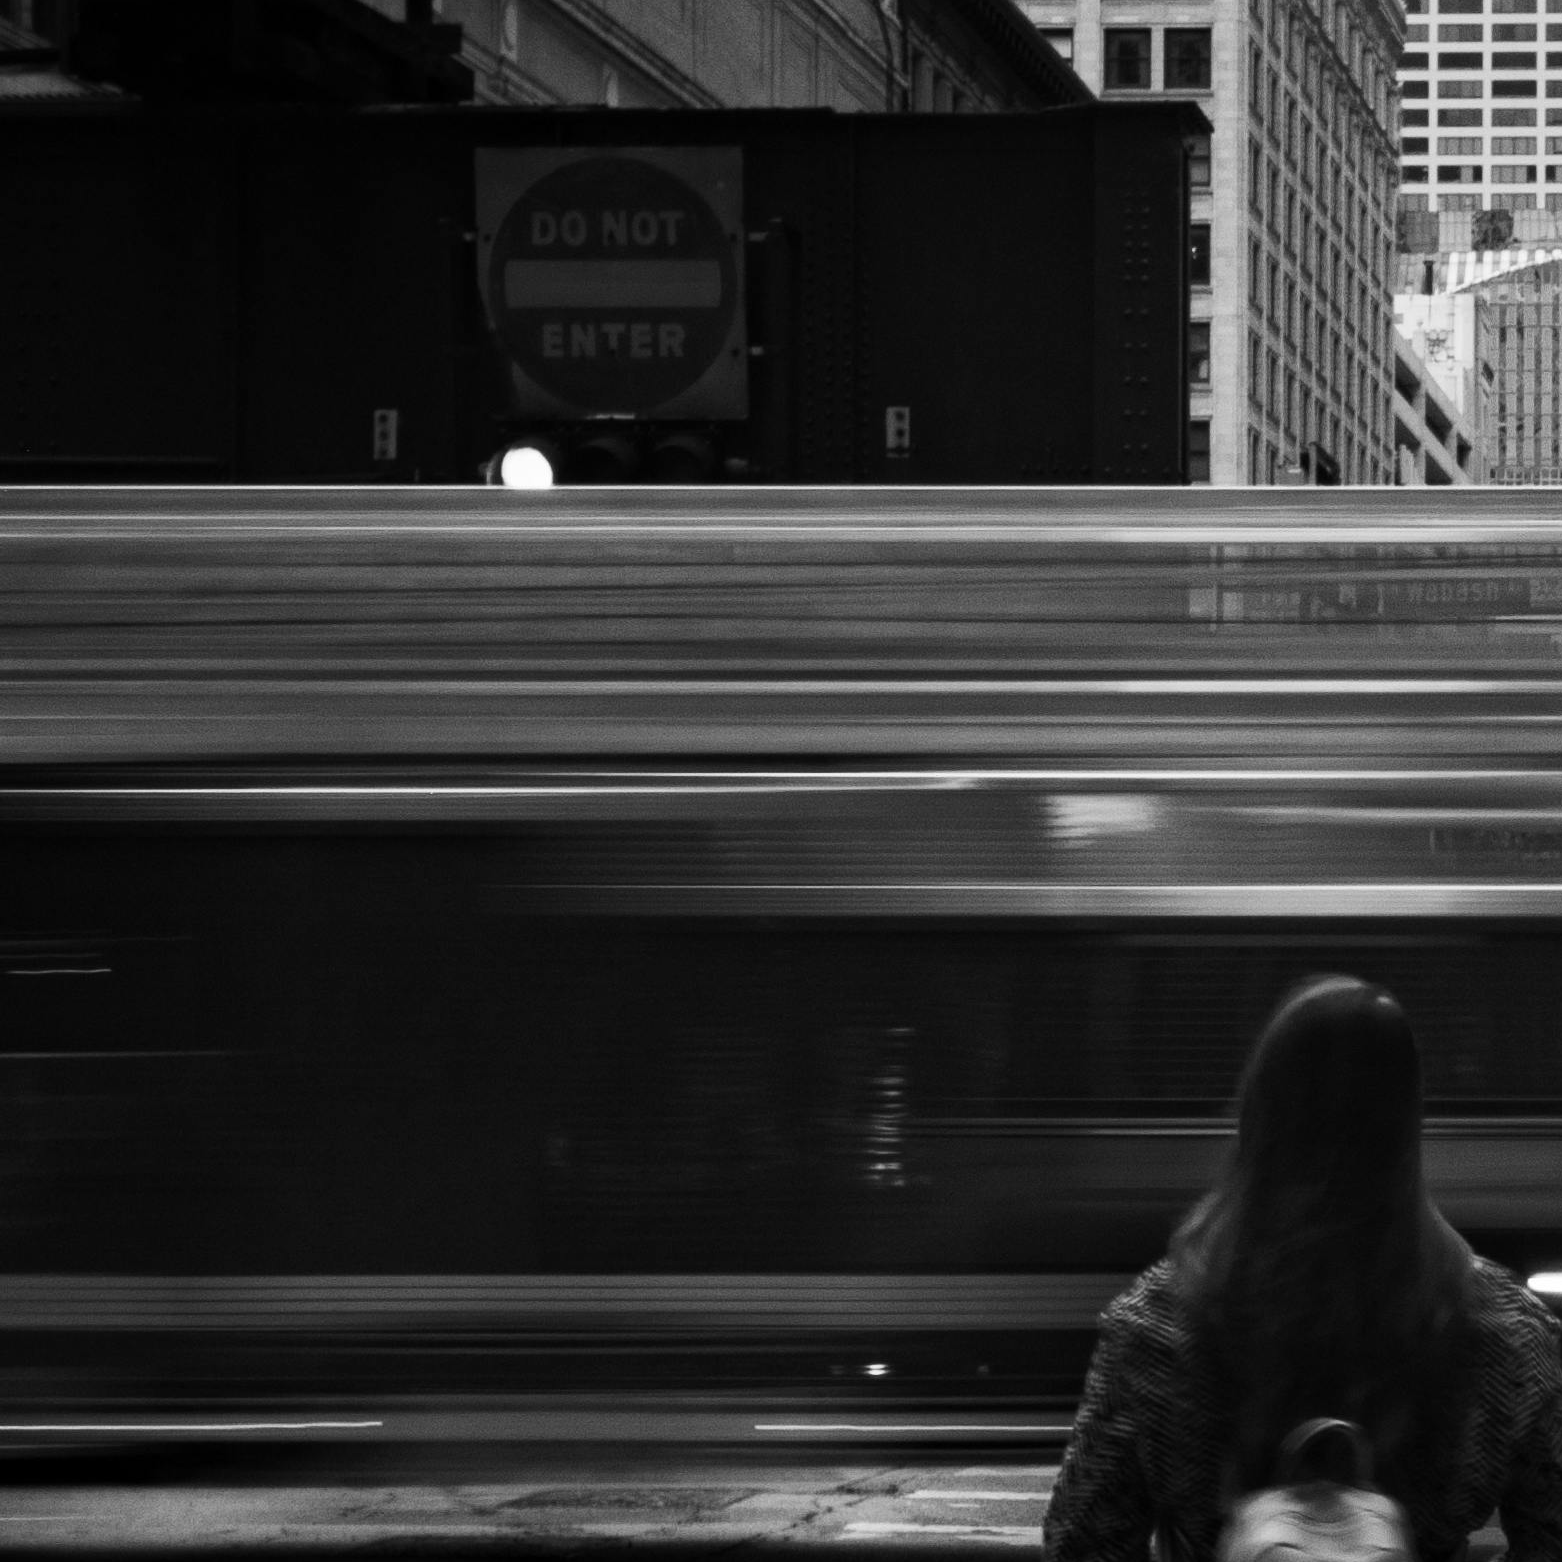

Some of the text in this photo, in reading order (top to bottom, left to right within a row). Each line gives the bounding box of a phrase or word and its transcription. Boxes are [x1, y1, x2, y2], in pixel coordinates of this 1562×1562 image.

[530, 209, 686, 248] DO NOT
[541, 322, 686, 359] ENTER
